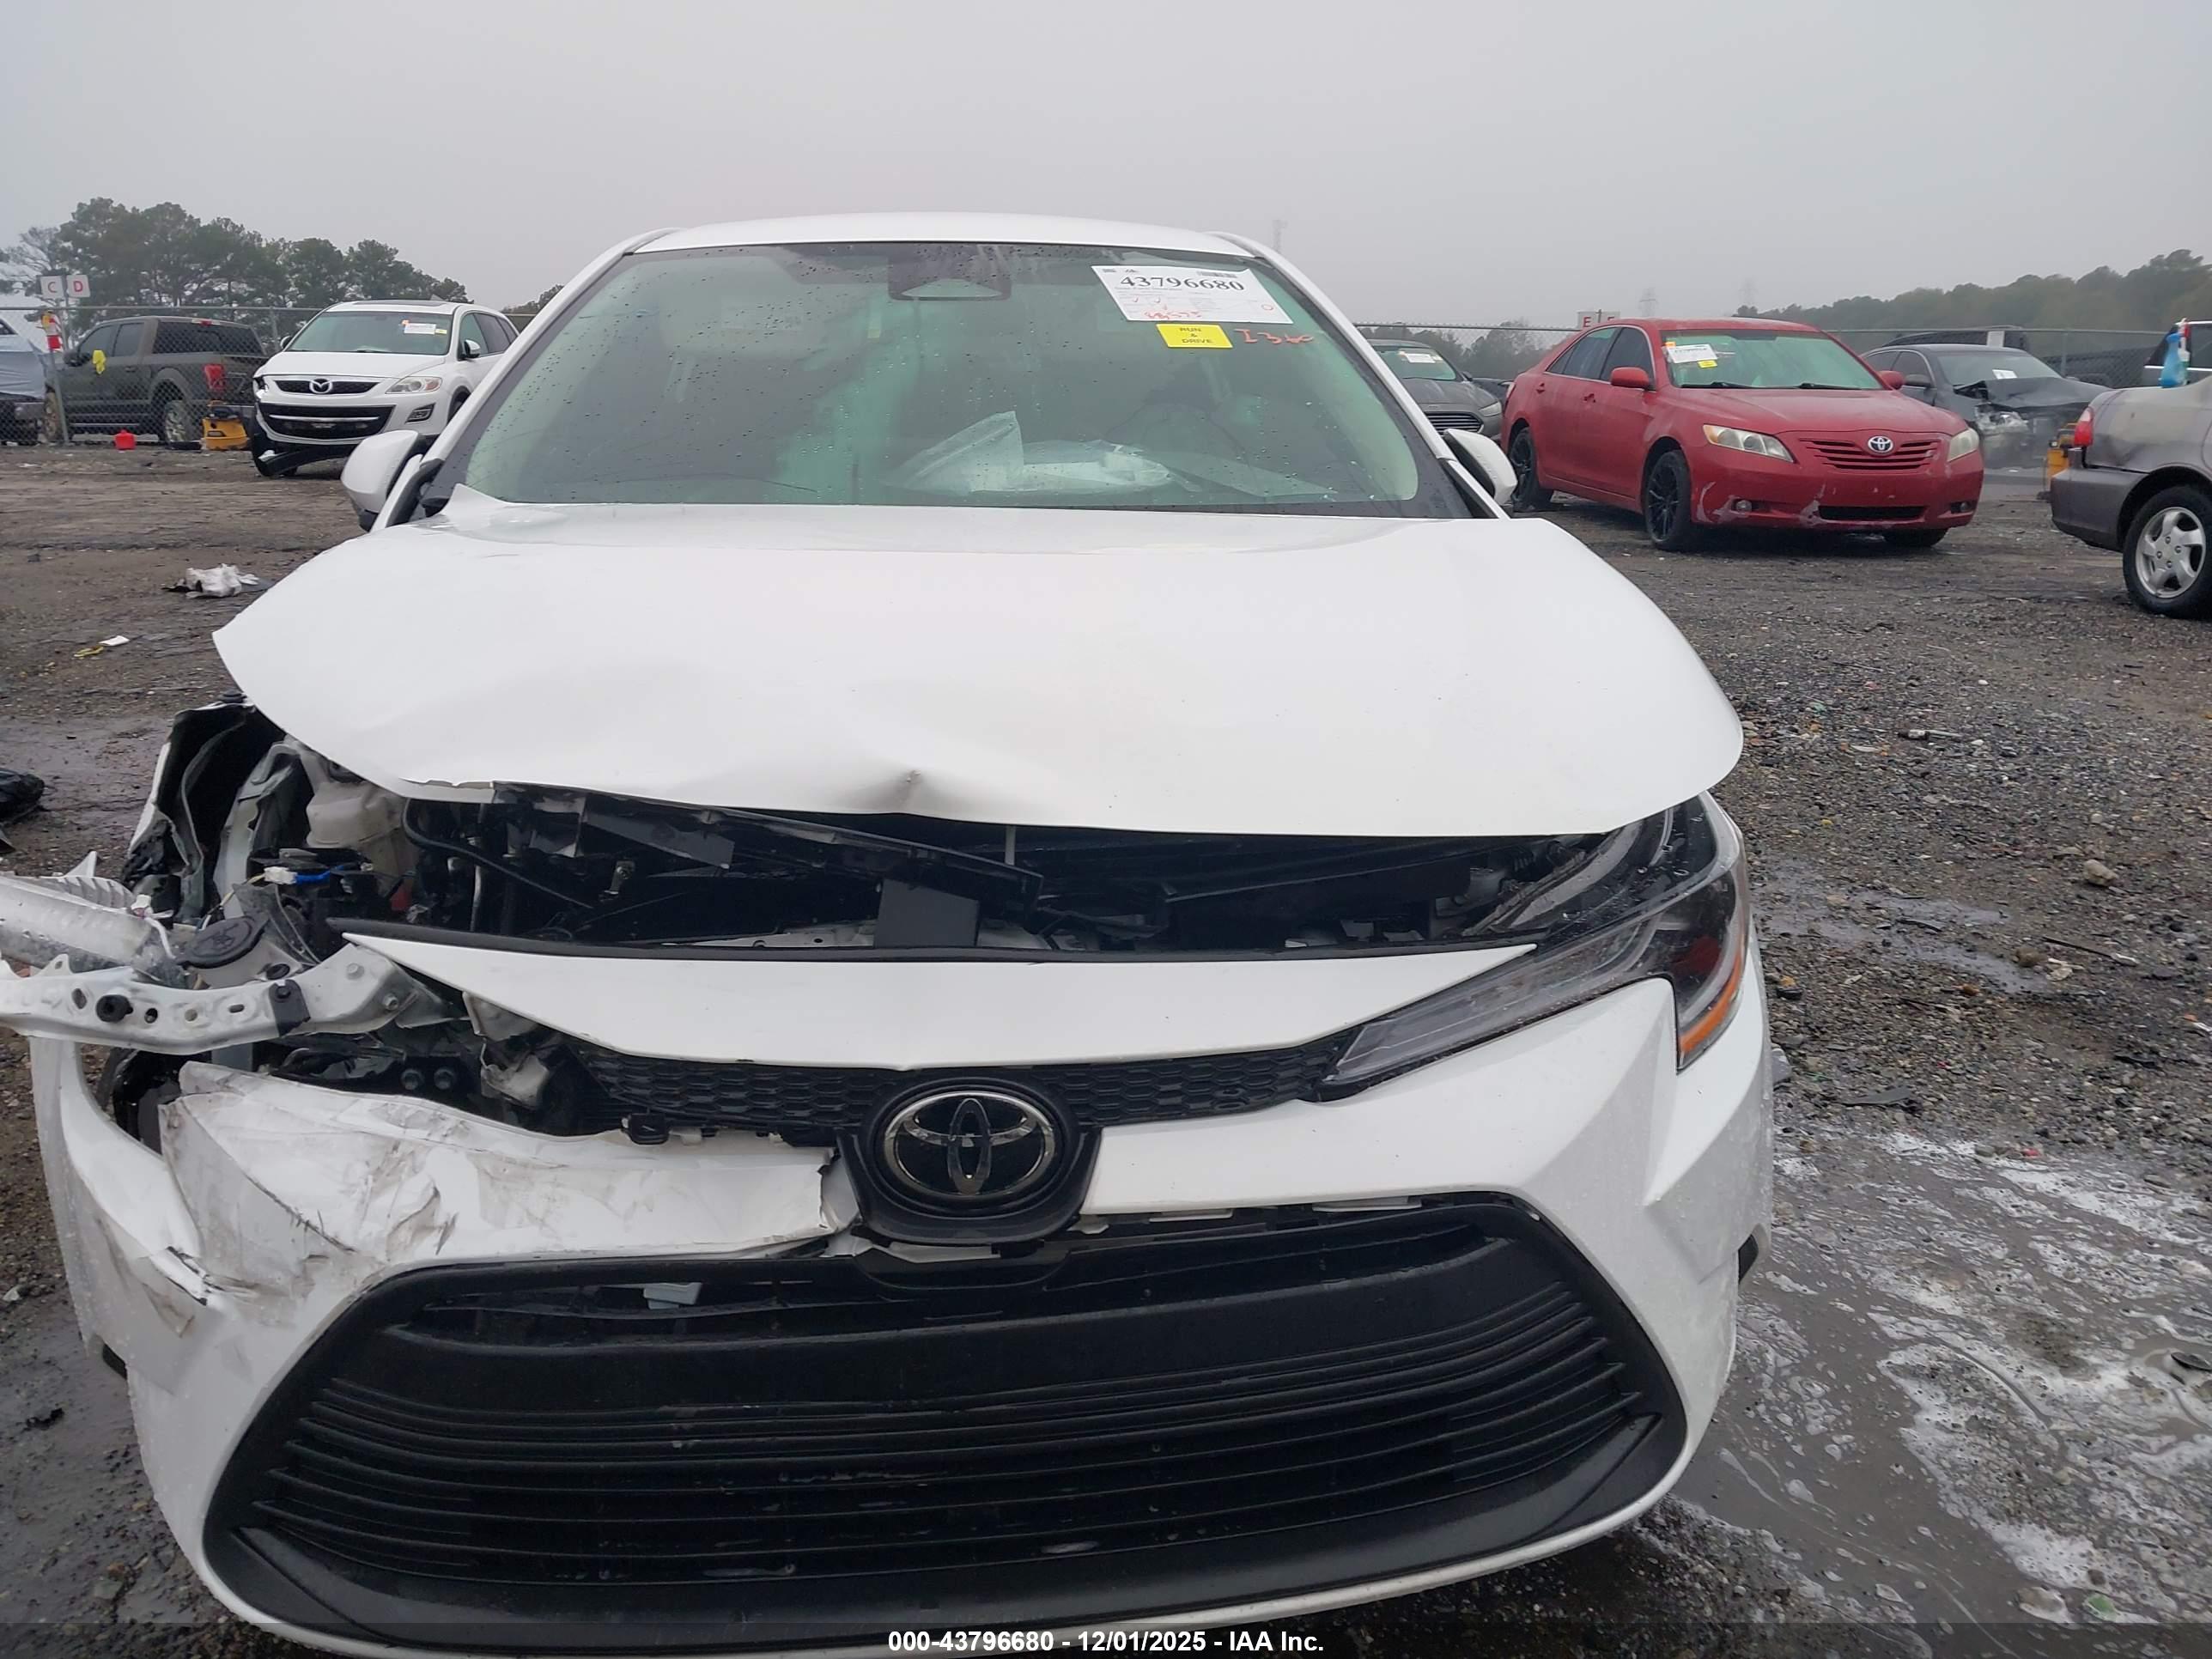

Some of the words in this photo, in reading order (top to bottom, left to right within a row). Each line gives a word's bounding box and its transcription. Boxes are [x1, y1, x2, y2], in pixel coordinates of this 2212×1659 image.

[47, 281, 58, 294] C
[73, 280, 83, 293] D
[1120, 276, 1245, 291] 43796680
[1583, 316, 1592, 328] E
